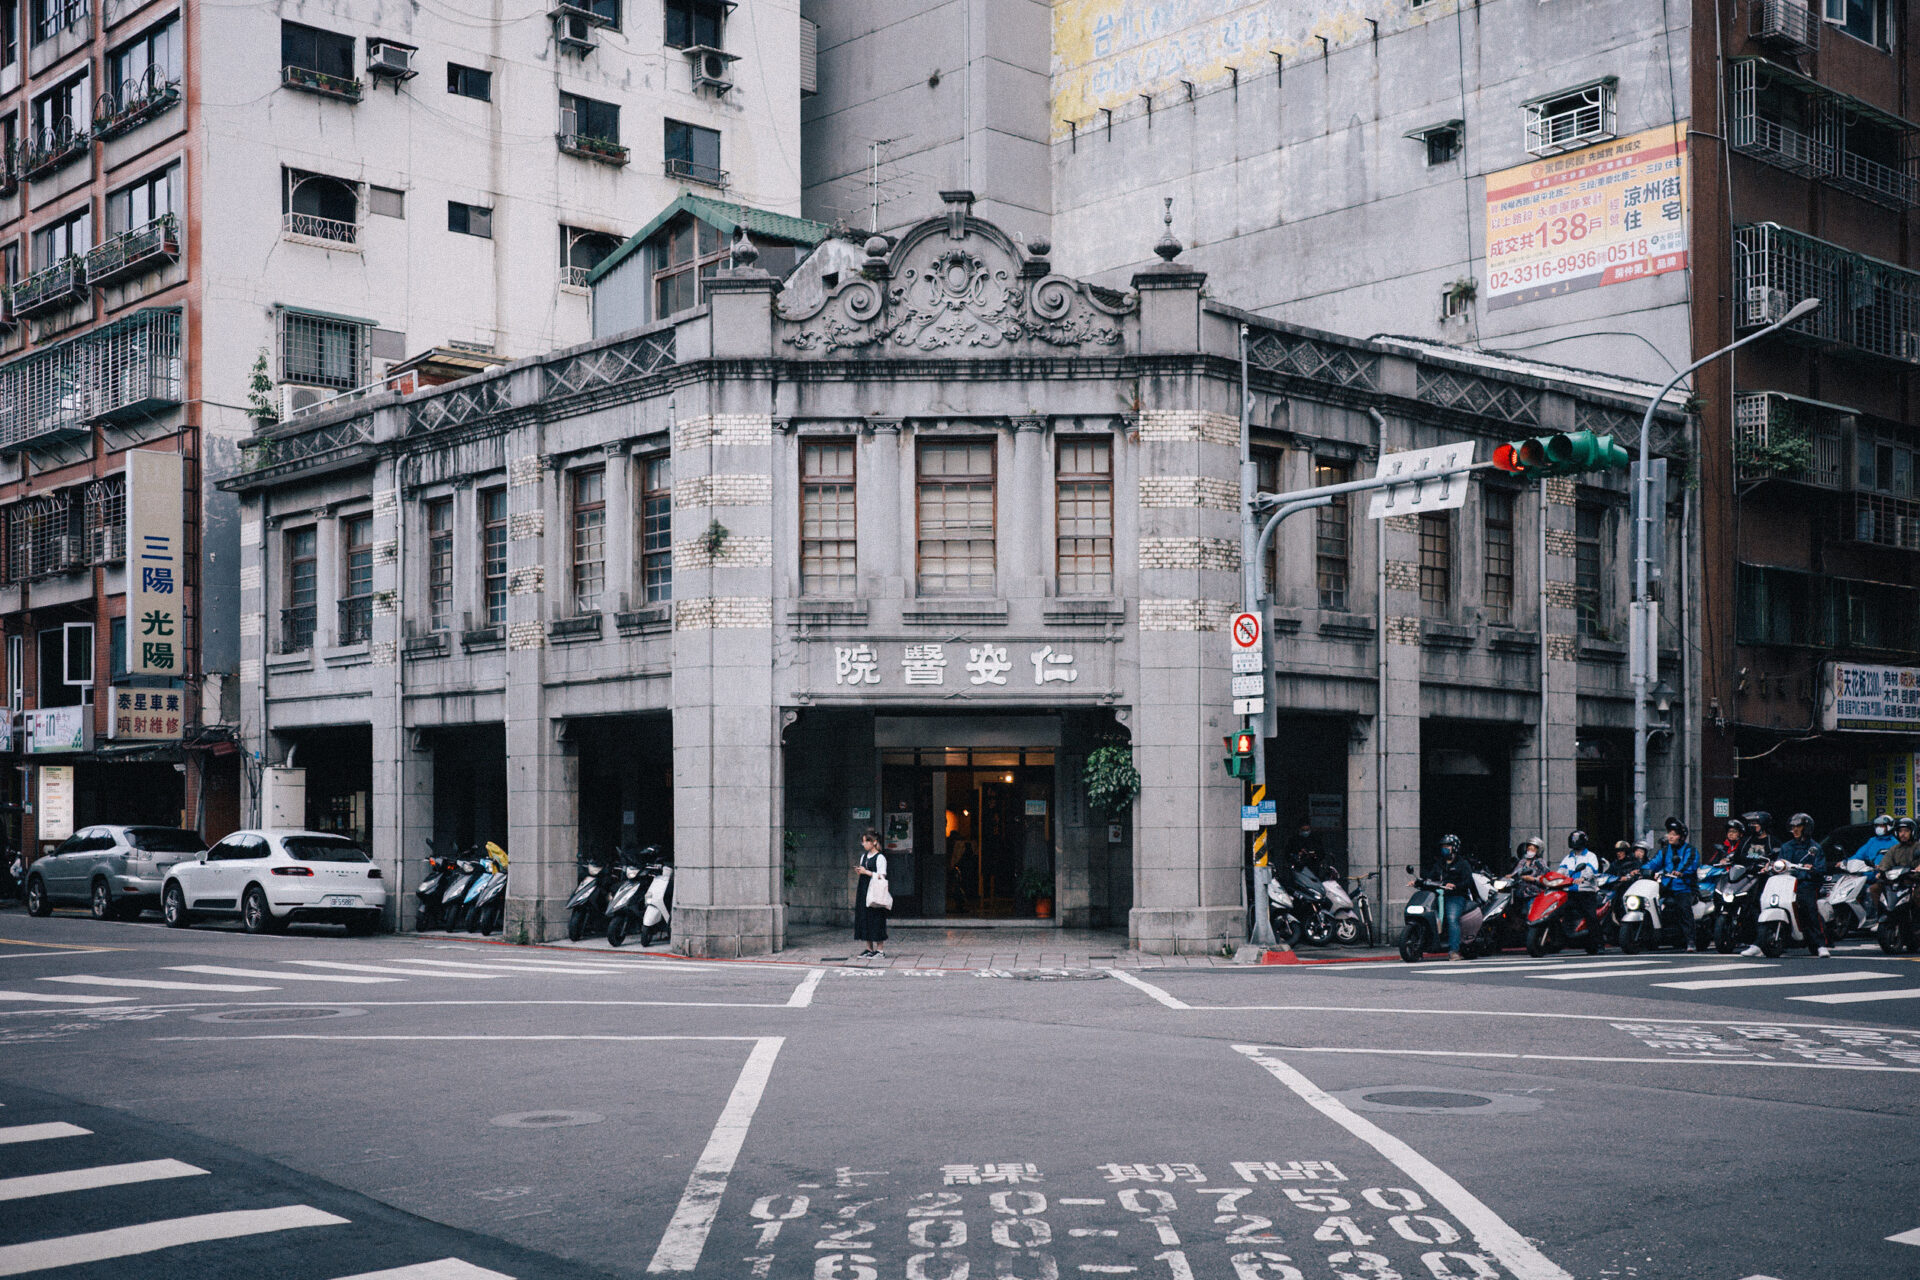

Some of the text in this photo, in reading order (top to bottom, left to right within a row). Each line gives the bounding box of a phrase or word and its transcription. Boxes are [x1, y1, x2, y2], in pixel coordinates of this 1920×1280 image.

[1623, 174, 1679, 209] 涼州街
[141, 535, 173, 594] 三陽
[141, 609, 174, 669] 光陽
[117, 693, 179, 711] 泰星車業
[117, 716, 179, 735] 噴射維修
